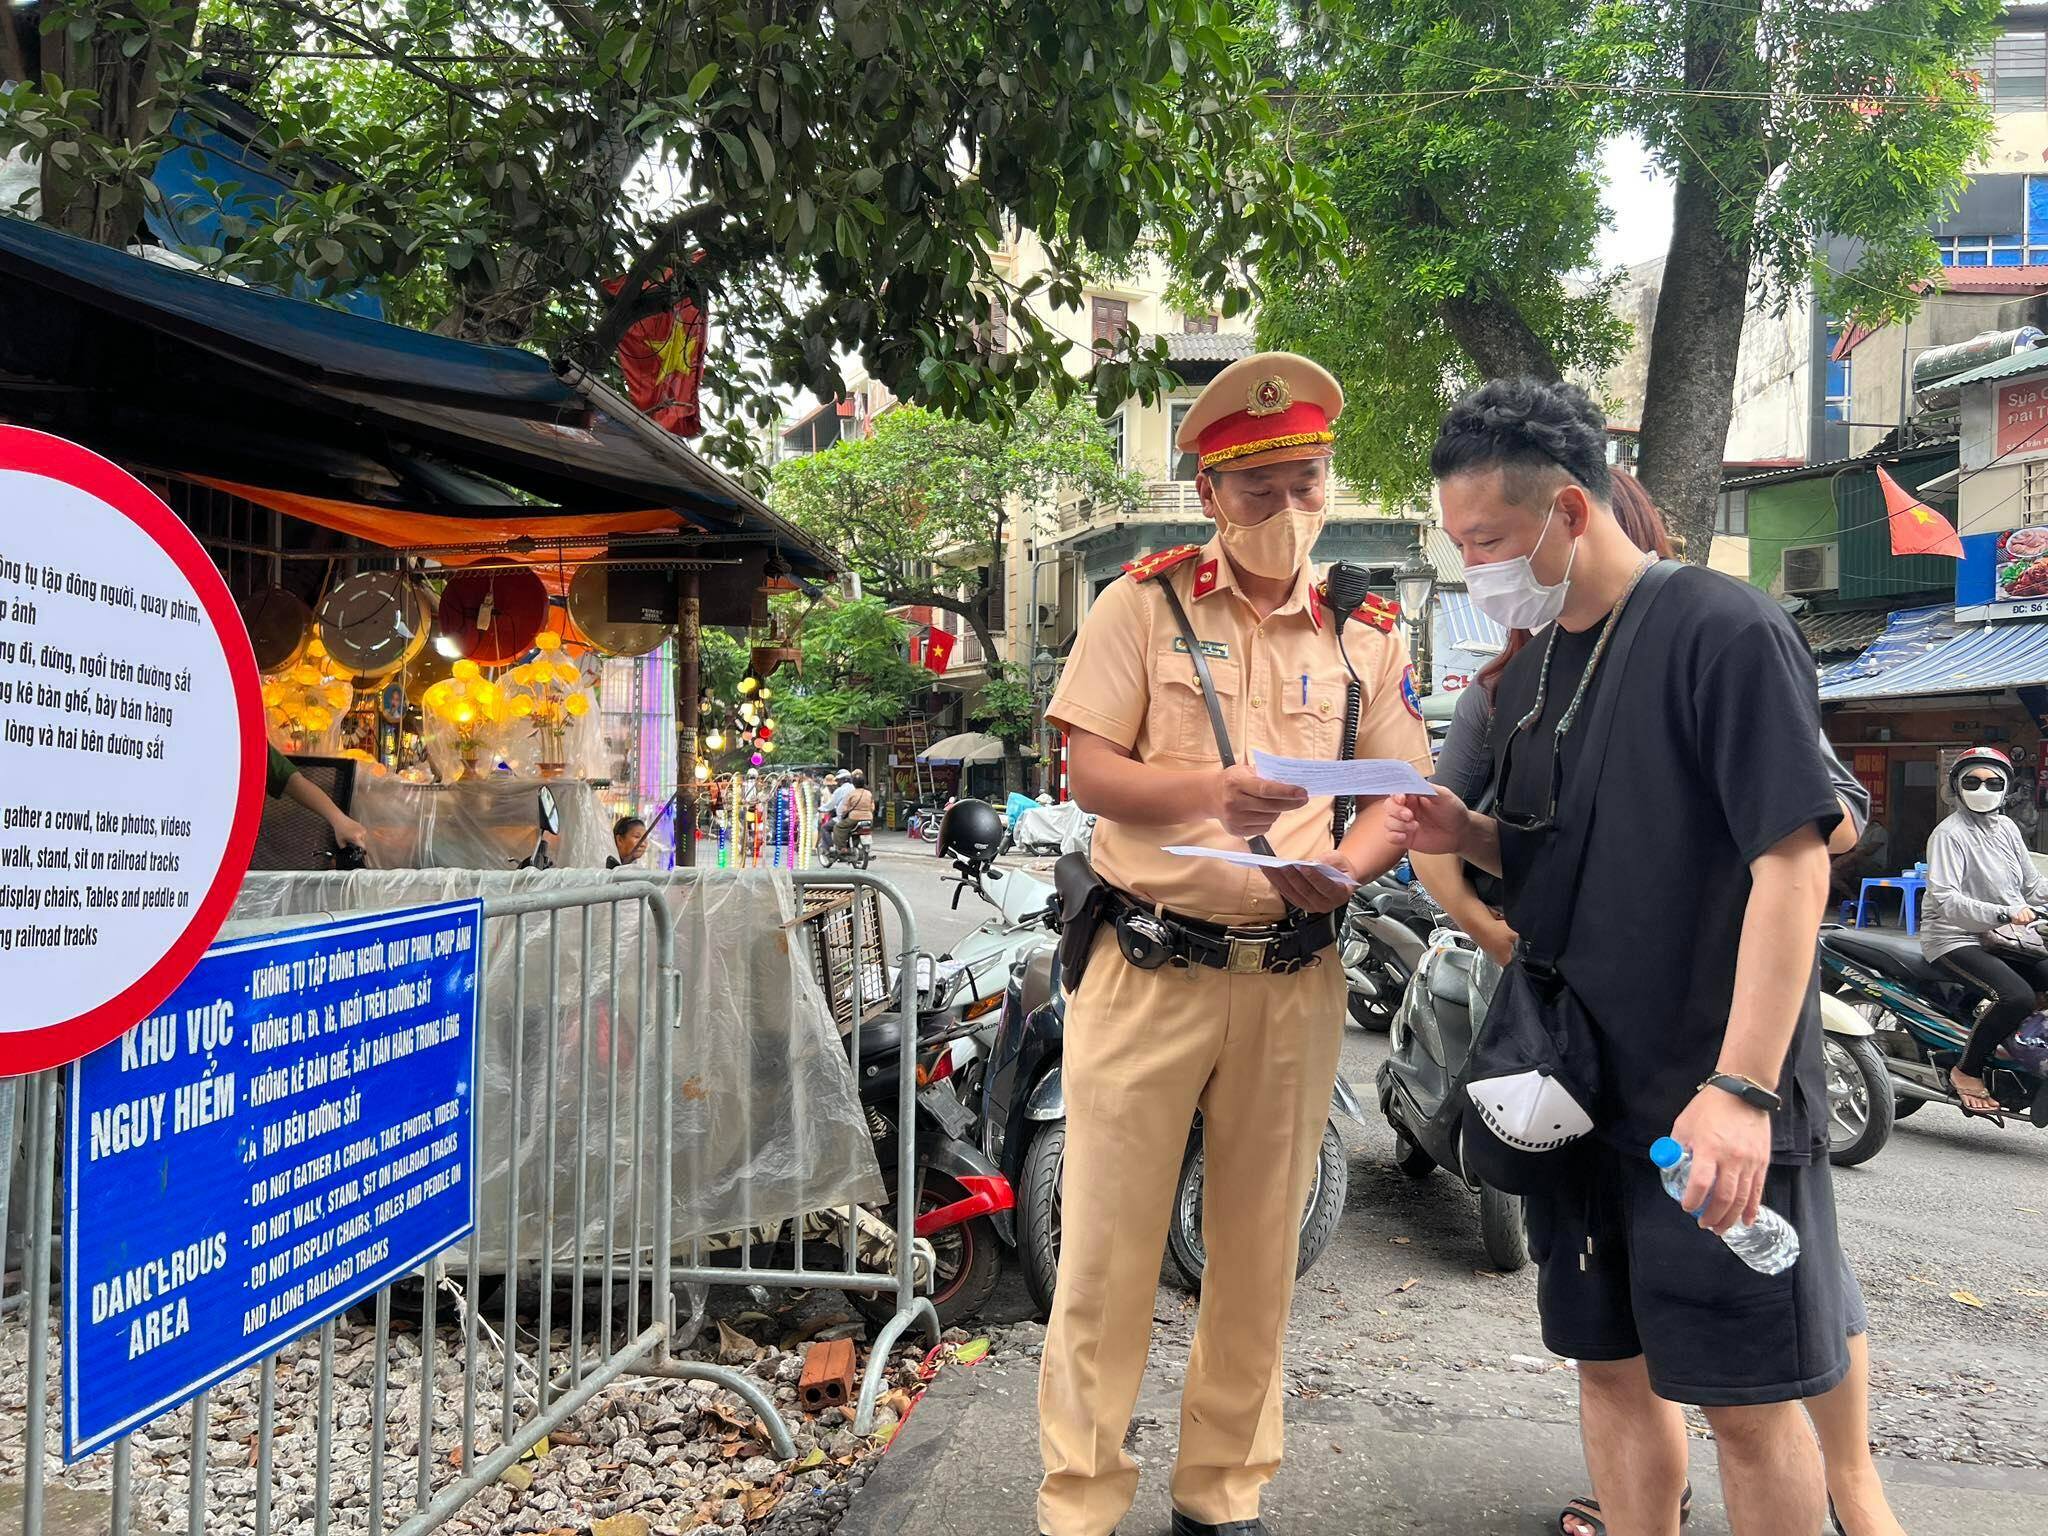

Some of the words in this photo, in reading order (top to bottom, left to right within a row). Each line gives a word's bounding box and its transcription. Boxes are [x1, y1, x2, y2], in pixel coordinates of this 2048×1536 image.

[12, 596, 36, 626] ảnh
[25, 561, 38, 590] tụ
[42, 566, 62, 594] tập
[66, 572, 97, 602] đông
[100, 581, 137, 612] người,
[140, 594, 168, 619] quay
[170, 600, 201, 626] phim,
[20, 641, 36, 668] đi,
[40, 645, 75, 675] đứng,
[80, 652, 107, 678] ngồi
[110, 658, 133, 683] trên
[137, 662, 171, 692] đường
[175, 667, 192, 693] sắt
[17, 680, 33, 705] kê
[37, 684, 61, 709] bàn
[65, 687, 92, 716] ghế,
[95, 692, 117, 720] bày
[120, 698, 142, 722] bán
[145, 701, 173, 728] hàng
[4, 718, 34, 747] lòng
[38, 723, 54, 747] và
[57, 725, 77, 750] hai
[81, 729, 103, 753] bên
[107, 733, 143, 760] đường
[146, 735, 164, 760] sắt
[4, 805, 42, 829] gather
[45, 811, 52, 829] a
[55, 810, 93, 834] crowd,
[96, 811, 119, 833] take
[121, 813, 158, 838] photos,
[160, 816, 191, 837] videos
[1, 845, 33, 871] walk,
[37, 847, 71, 872] stand,
[75, 848, 89, 870] sit
[91, 852, 104, 870] on
[107, 849, 147, 872] railroad
[150, 851, 180, 872] tracks
[0, 885, 41, 910] display
[44, 885, 82, 910] chairs,
[86, 886, 119, 908] Tables
[121, 888, 140, 908] and
[142, 887, 175, 910] peddle
[177, 890, 189, 908] on
[15, 924, 61, 948] railroad
[64, 924, 98, 946] tracks
[252, 959, 290, 1000] KHÔNG
[292, 960, 305, 996] TỤ
[308, 950, 327, 993] TẬP
[329, 946, 355, 983] ĐÔNG
[357, 937, 386, 976] NGƯỜI,
[388, 938, 410, 971] QUAY
[411, 934, 433, 963] PHIM,
[435, 929, 455, 960] CHỤP
[456, 917, 472, 953] ẢNH
[121, 1013, 177, 1072] KHU
[186, 998, 234, 1060] VỰC
[251, 1013, 289, 1054] KHÔNG
[291, 1012, 305, 1044] ĐI,
[340, 988, 363, 1029] NGỒI
[364, 986, 387, 1022] TRÊN
[388, 979, 415, 1015] ĐƯỜNG
[417, 970, 432, 1007] SẮT
[250, 1066, 289, 1108] KHÔNG
[291, 1056, 305, 1095] KÊ
[307, 1052, 328, 1089] BÀN
[330, 1040, 351, 1081] GHẾ,
[373, 1032, 391, 1067] BÁN
[392, 1026, 414, 1060] HÀNG
[415, 1019, 440, 1052] TRONG
[441, 1010, 460, 1042] LÒNG
[90, 1092, 167, 1161] NGUY
[173, 1060, 235, 1134] HIỂM
[263, 1121, 282, 1157] HAI
[285, 1109, 306, 1149] BÊN
[308, 1099, 341, 1140] ĐƯỜNG
[343, 1086, 361, 1126] SẮT
[252, 1180, 267, 1207] DO
[270, 1169, 291, 1200] NOT
[293, 1153, 332, 1190] GATHER
[333, 1150, 341, 1173] A
[380, 1123, 401, 1152] TAKE
[402, 1110, 433, 1142] PHOTOS,
[434, 1098, 460, 1127] VIDEOS
[251, 1221, 267, 1249] DO
[270, 1210, 291, 1241] NOT
[293, 1195, 325, 1230] WALK,
[328, 1179, 360, 1213] STAND,
[363, 1170, 377, 1196] SIT
[378, 1164, 391, 1189] ON
[392, 1145, 429, 1182] RAILROAD
[431, 1132, 458, 1162] TRACKS
[251, 1262, 266, 1290] DO
[269, 1249, 291, 1282] NOT
[293, 1228, 335, 1269] DISPLAY
[336, 1211, 372, 1247] CHAIRS,
[374, 1192, 405, 1227] TABLES
[405, 1183, 422, 1211] AND
[423, 1168, 450, 1201] PEDDLE
[451, 1162, 461, 1185] ON
[243, 1302, 267, 1337] AND
[269, 1283, 304, 1323] ALONG
[306, 1256, 354, 1302] RAILROAD
[355, 1237, 389, 1274] TRACKS
[128, 1296, 190, 1361] AREA
